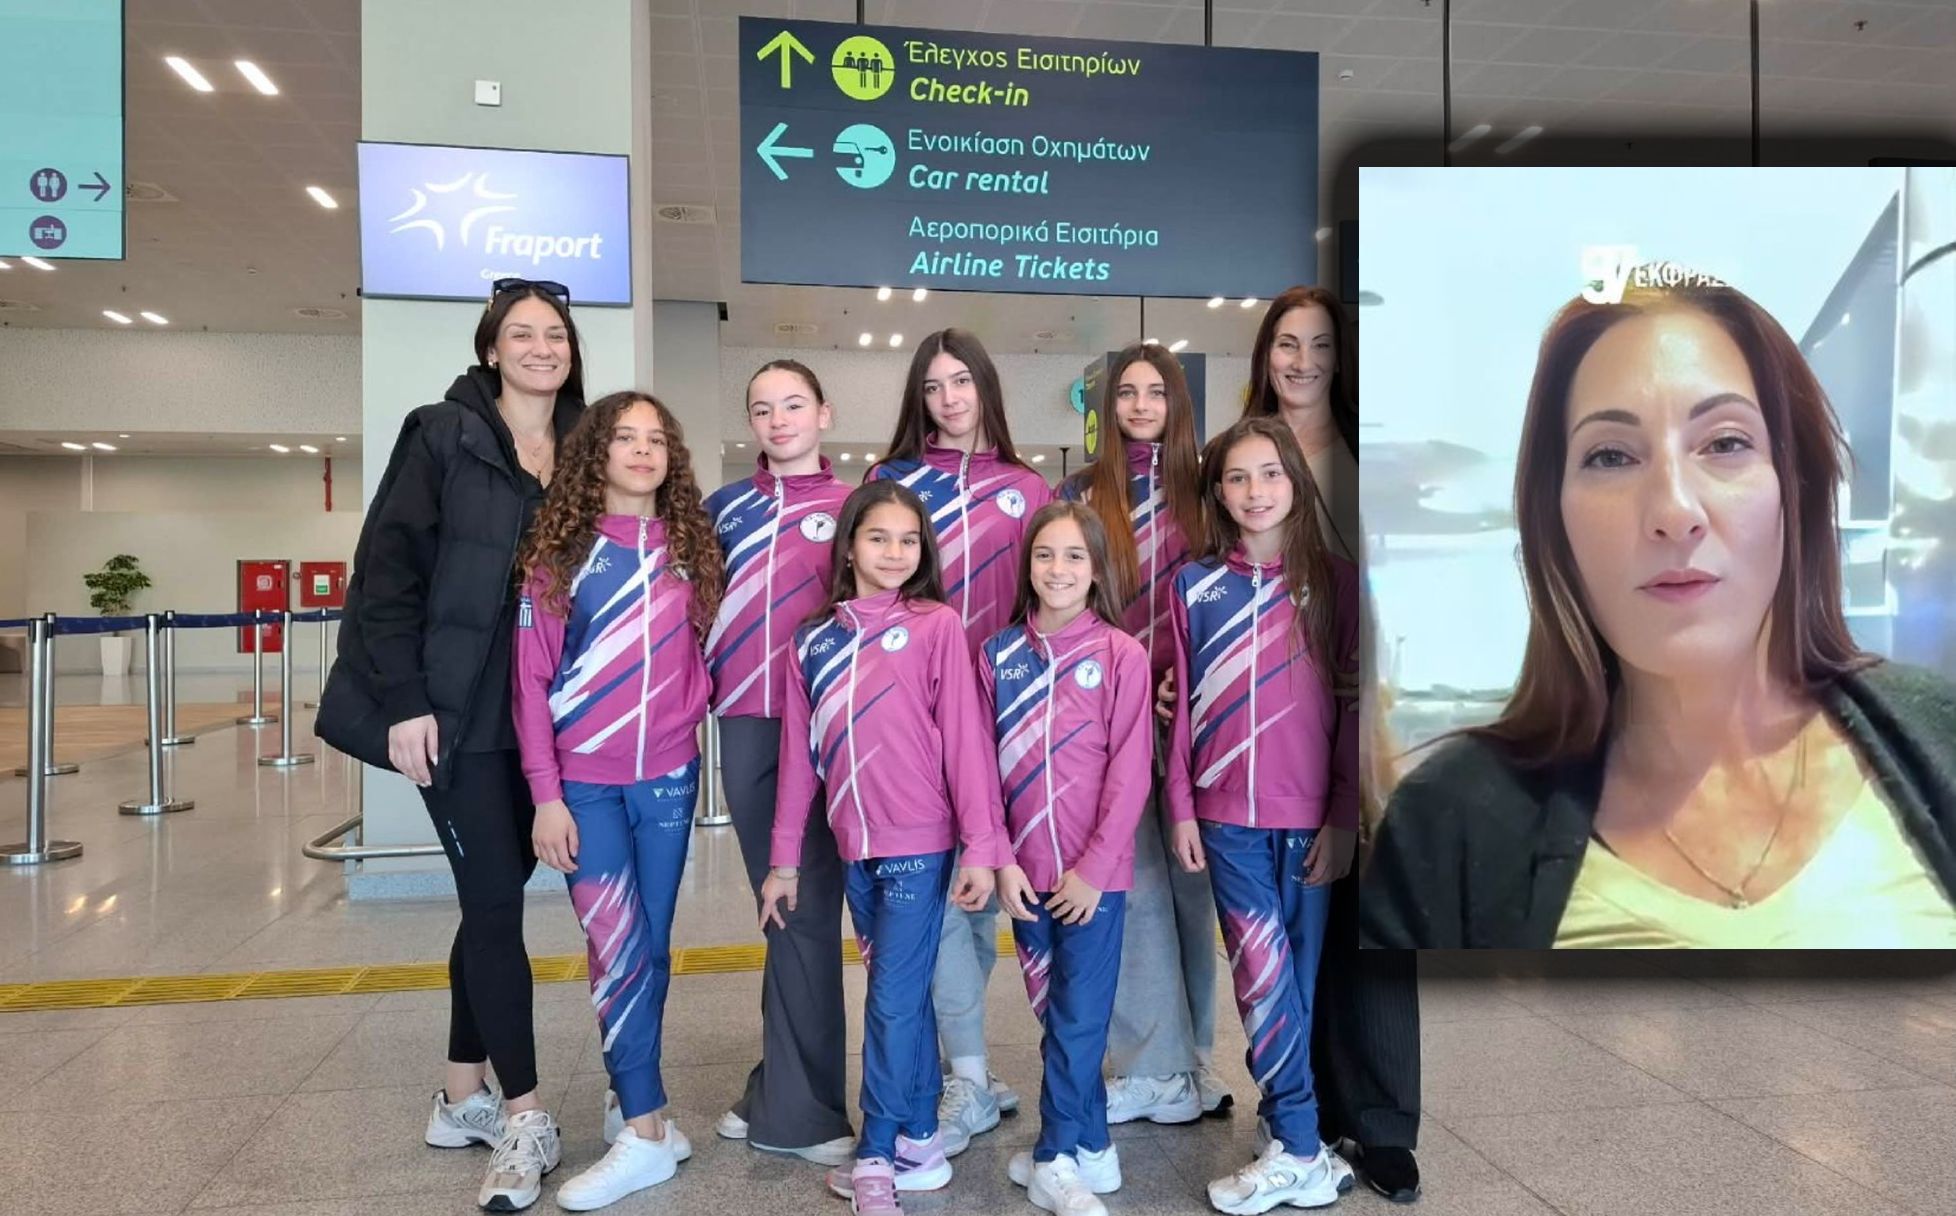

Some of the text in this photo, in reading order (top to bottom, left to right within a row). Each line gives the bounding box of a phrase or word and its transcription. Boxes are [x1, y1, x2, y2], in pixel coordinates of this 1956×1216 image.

[904, 40, 1141, 78] Έλεγχος Εισιτηρίων
[910, 77, 1029, 107] Check-in
[908, 128, 1151, 163] Ενοικίαση Οχημάτων
[909, 164, 1049, 195] Car rental
[484, 225, 604, 265] Fraport
[908, 216, 1159, 249] Αεροπορικά Εισιτήρια
[909, 251, 1111, 281] Airline Tickets
[884, 859, 926, 874] VAVLIS
